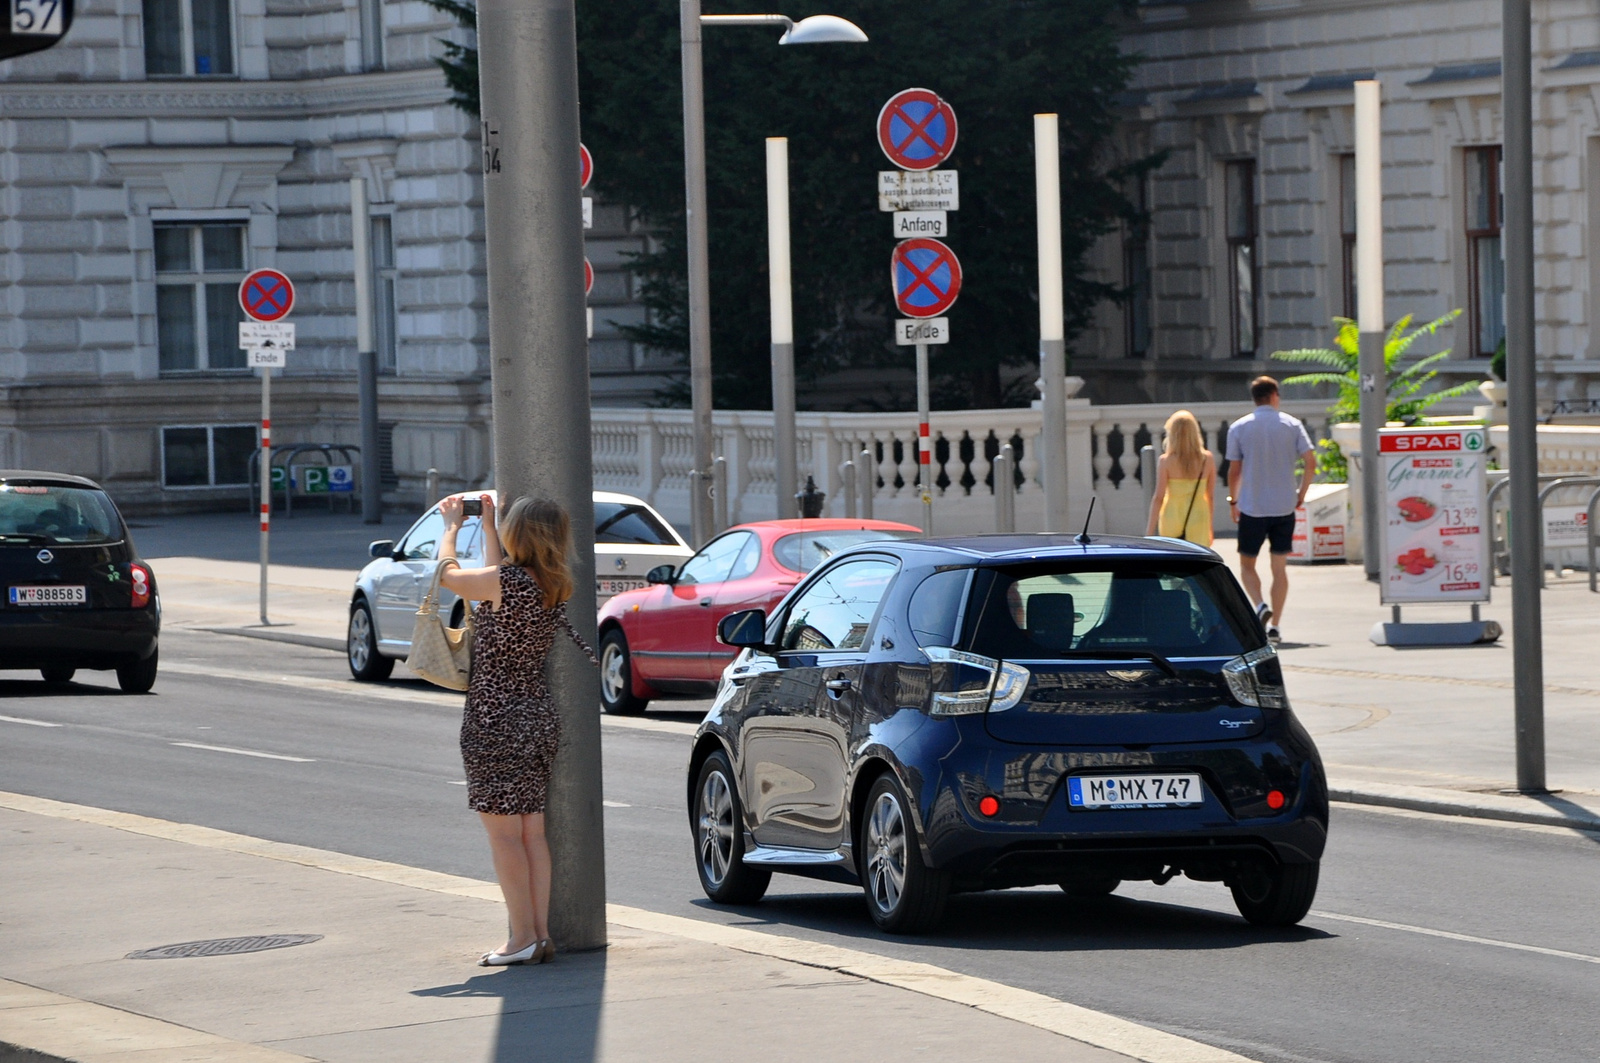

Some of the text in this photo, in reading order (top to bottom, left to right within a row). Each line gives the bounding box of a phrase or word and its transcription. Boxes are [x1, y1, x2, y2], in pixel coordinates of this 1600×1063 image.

[15, 0, 58, 31] 57
[901, 217, 942, 235] Anfang
[905, 324, 940, 340] Ende
[255, 352, 279, 364] Ende
[1395, 435, 1460, 450] SPAR
[1420, 459, 1453, 468] SPAR
[305, 469, 322, 491] P
[1388, 455, 1478, 491] Gourmet
[18, 588, 82, 600] W 98858 S
[1090, 780, 1105, 801] M
[1119, 779, 1149, 801] MX
[1151, 778, 1191, 800] 747
